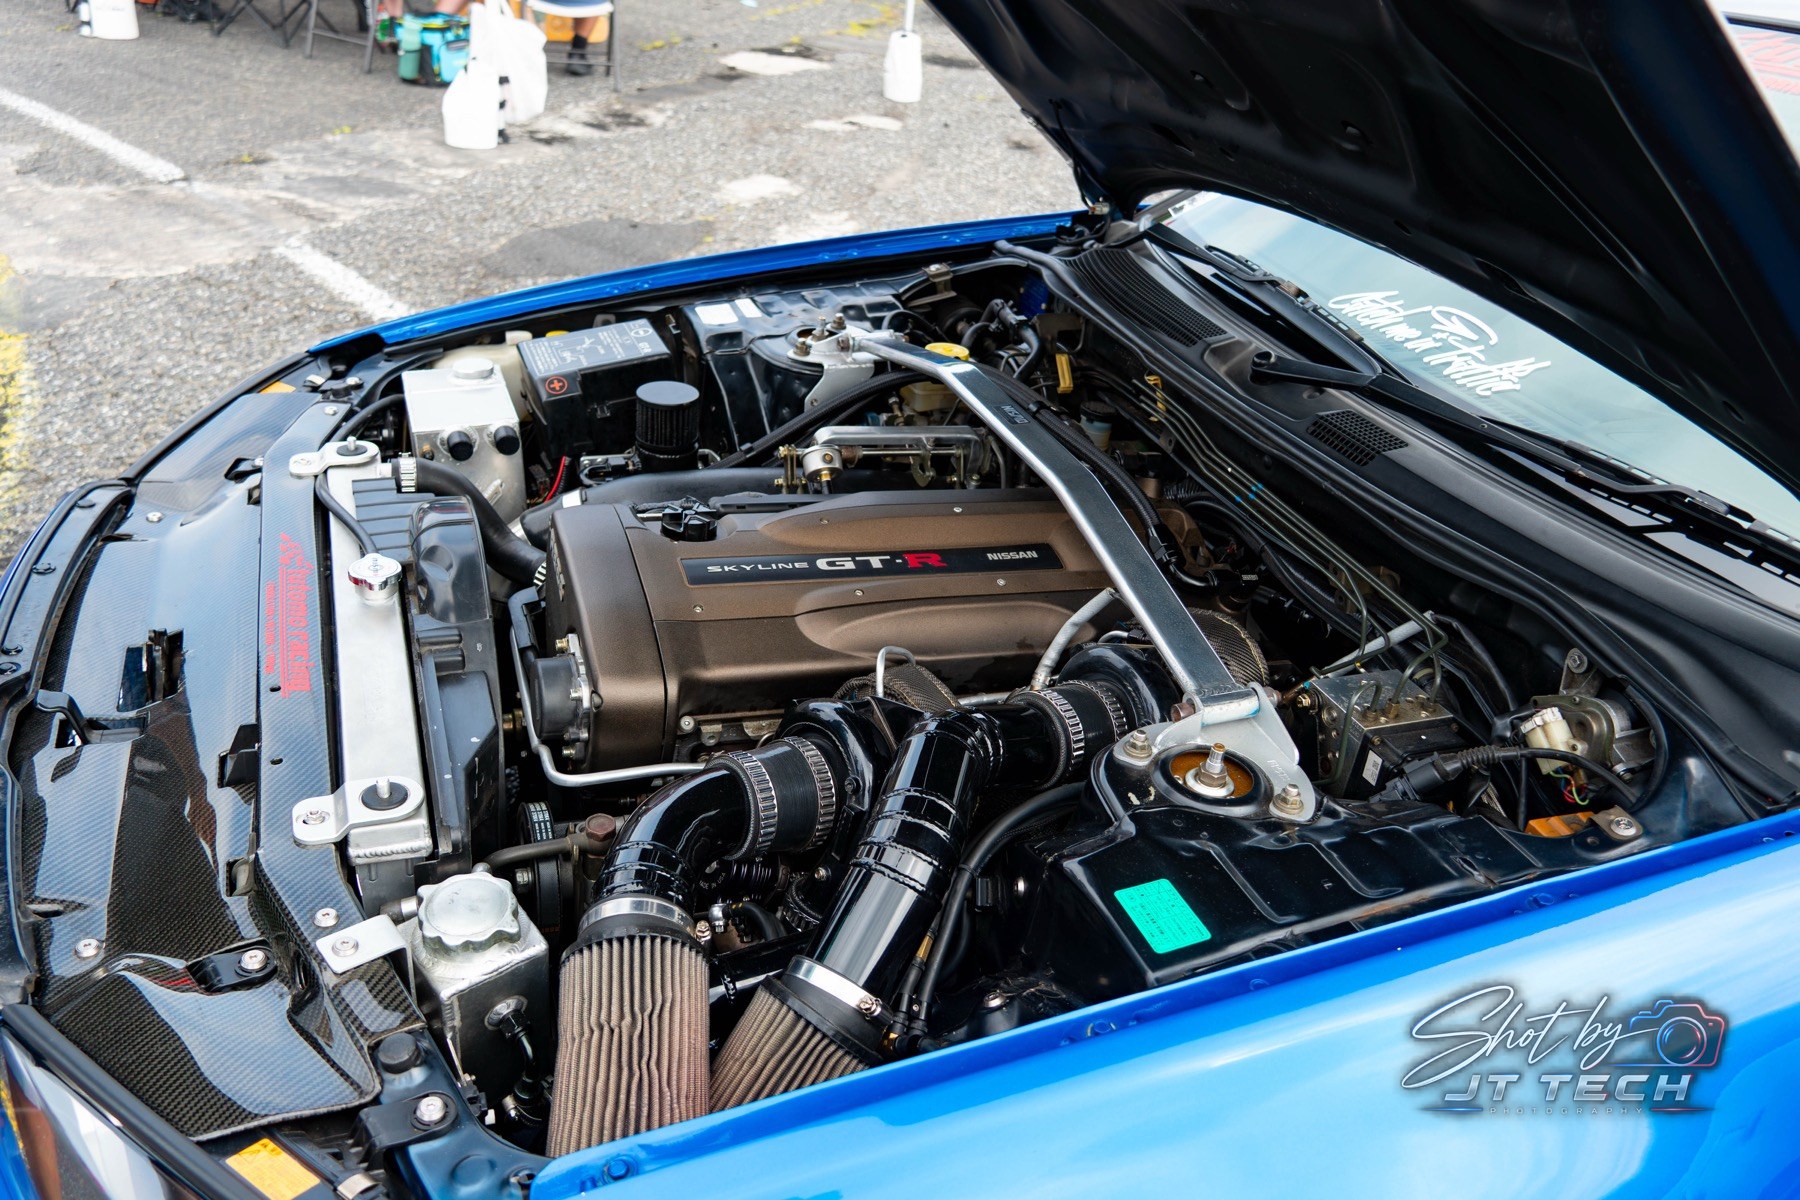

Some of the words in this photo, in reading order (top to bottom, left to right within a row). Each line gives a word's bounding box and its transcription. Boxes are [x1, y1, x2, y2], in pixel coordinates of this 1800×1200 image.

[987, 550, 1039, 560] NISSAN
[706, 561, 810, 573] SKYLINE
[816, 553, 947, 571] GT-R
